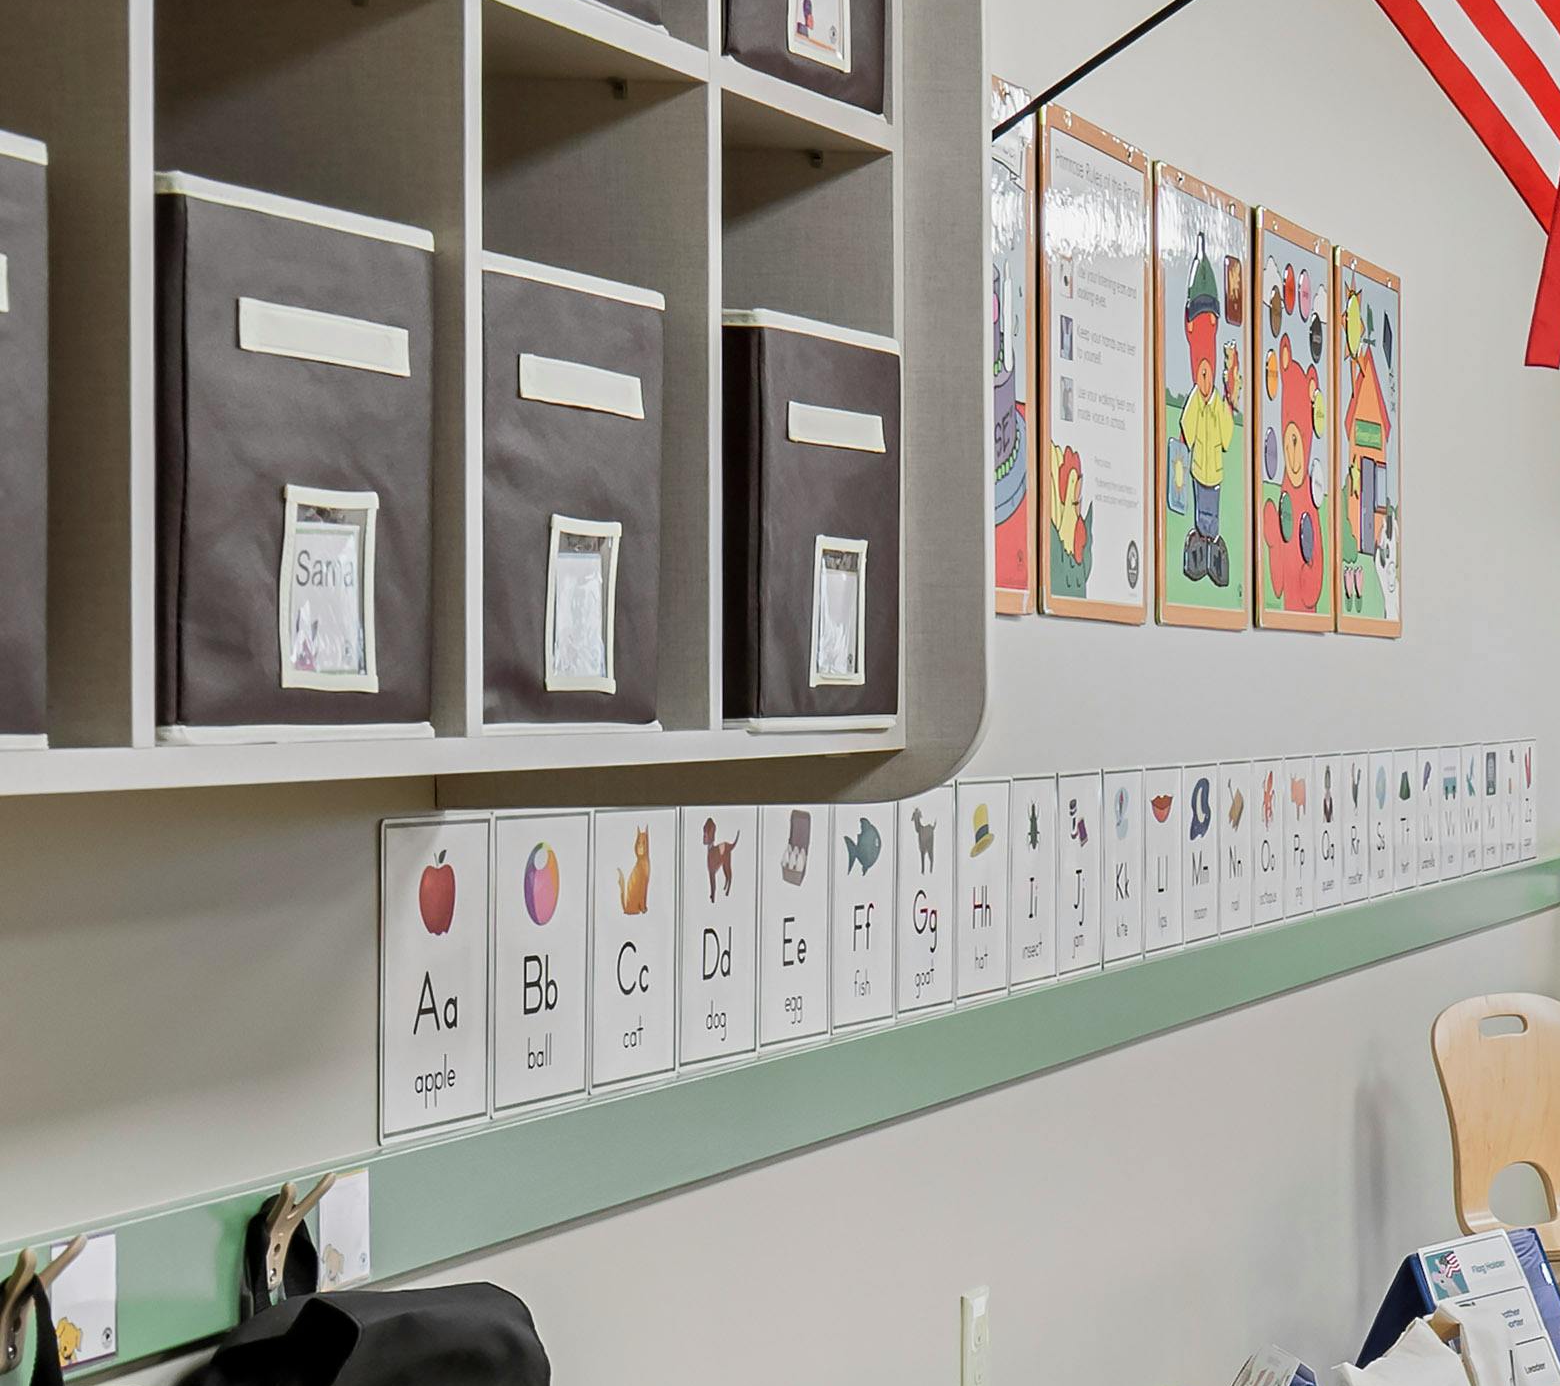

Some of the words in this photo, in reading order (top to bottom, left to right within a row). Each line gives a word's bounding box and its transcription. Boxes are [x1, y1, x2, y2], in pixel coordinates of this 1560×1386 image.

[1260, 839, 1276, 872] Oo
[1293, 834, 1305, 879] Pp
[1376, 821, 1386, 851] Ss
[1115, 862, 1131, 902] Kk
[1191, 850, 1209, 887] Mm
[1229, 845, 1242, 879] Nn
[973, 885, 992, 930] Hh
[1028, 876, 1039, 919] Ii
[1073, 869, 1086, 927] Jj
[782, 916, 807, 967] Ee
[853, 902, 875, 952] Ff
[912, 889, 938, 953] Gg
[616, 942, 649, 996] Cc
[702, 926, 732, 981] Dd
[523, 954, 558, 1015] Bb
[854, 968, 871, 998] fish
[914, 959, 935, 999] goat
[413, 970, 459, 1035] Aa
[705, 999, 727, 1042] dog
[784, 995, 802, 1025] egg
[527, 1032, 552, 1070] ball
[622, 1015, 643, 1049] cat
[414, 1053, 456, 1109] apple
[1524, 1362, 1546, 1374] Leader
